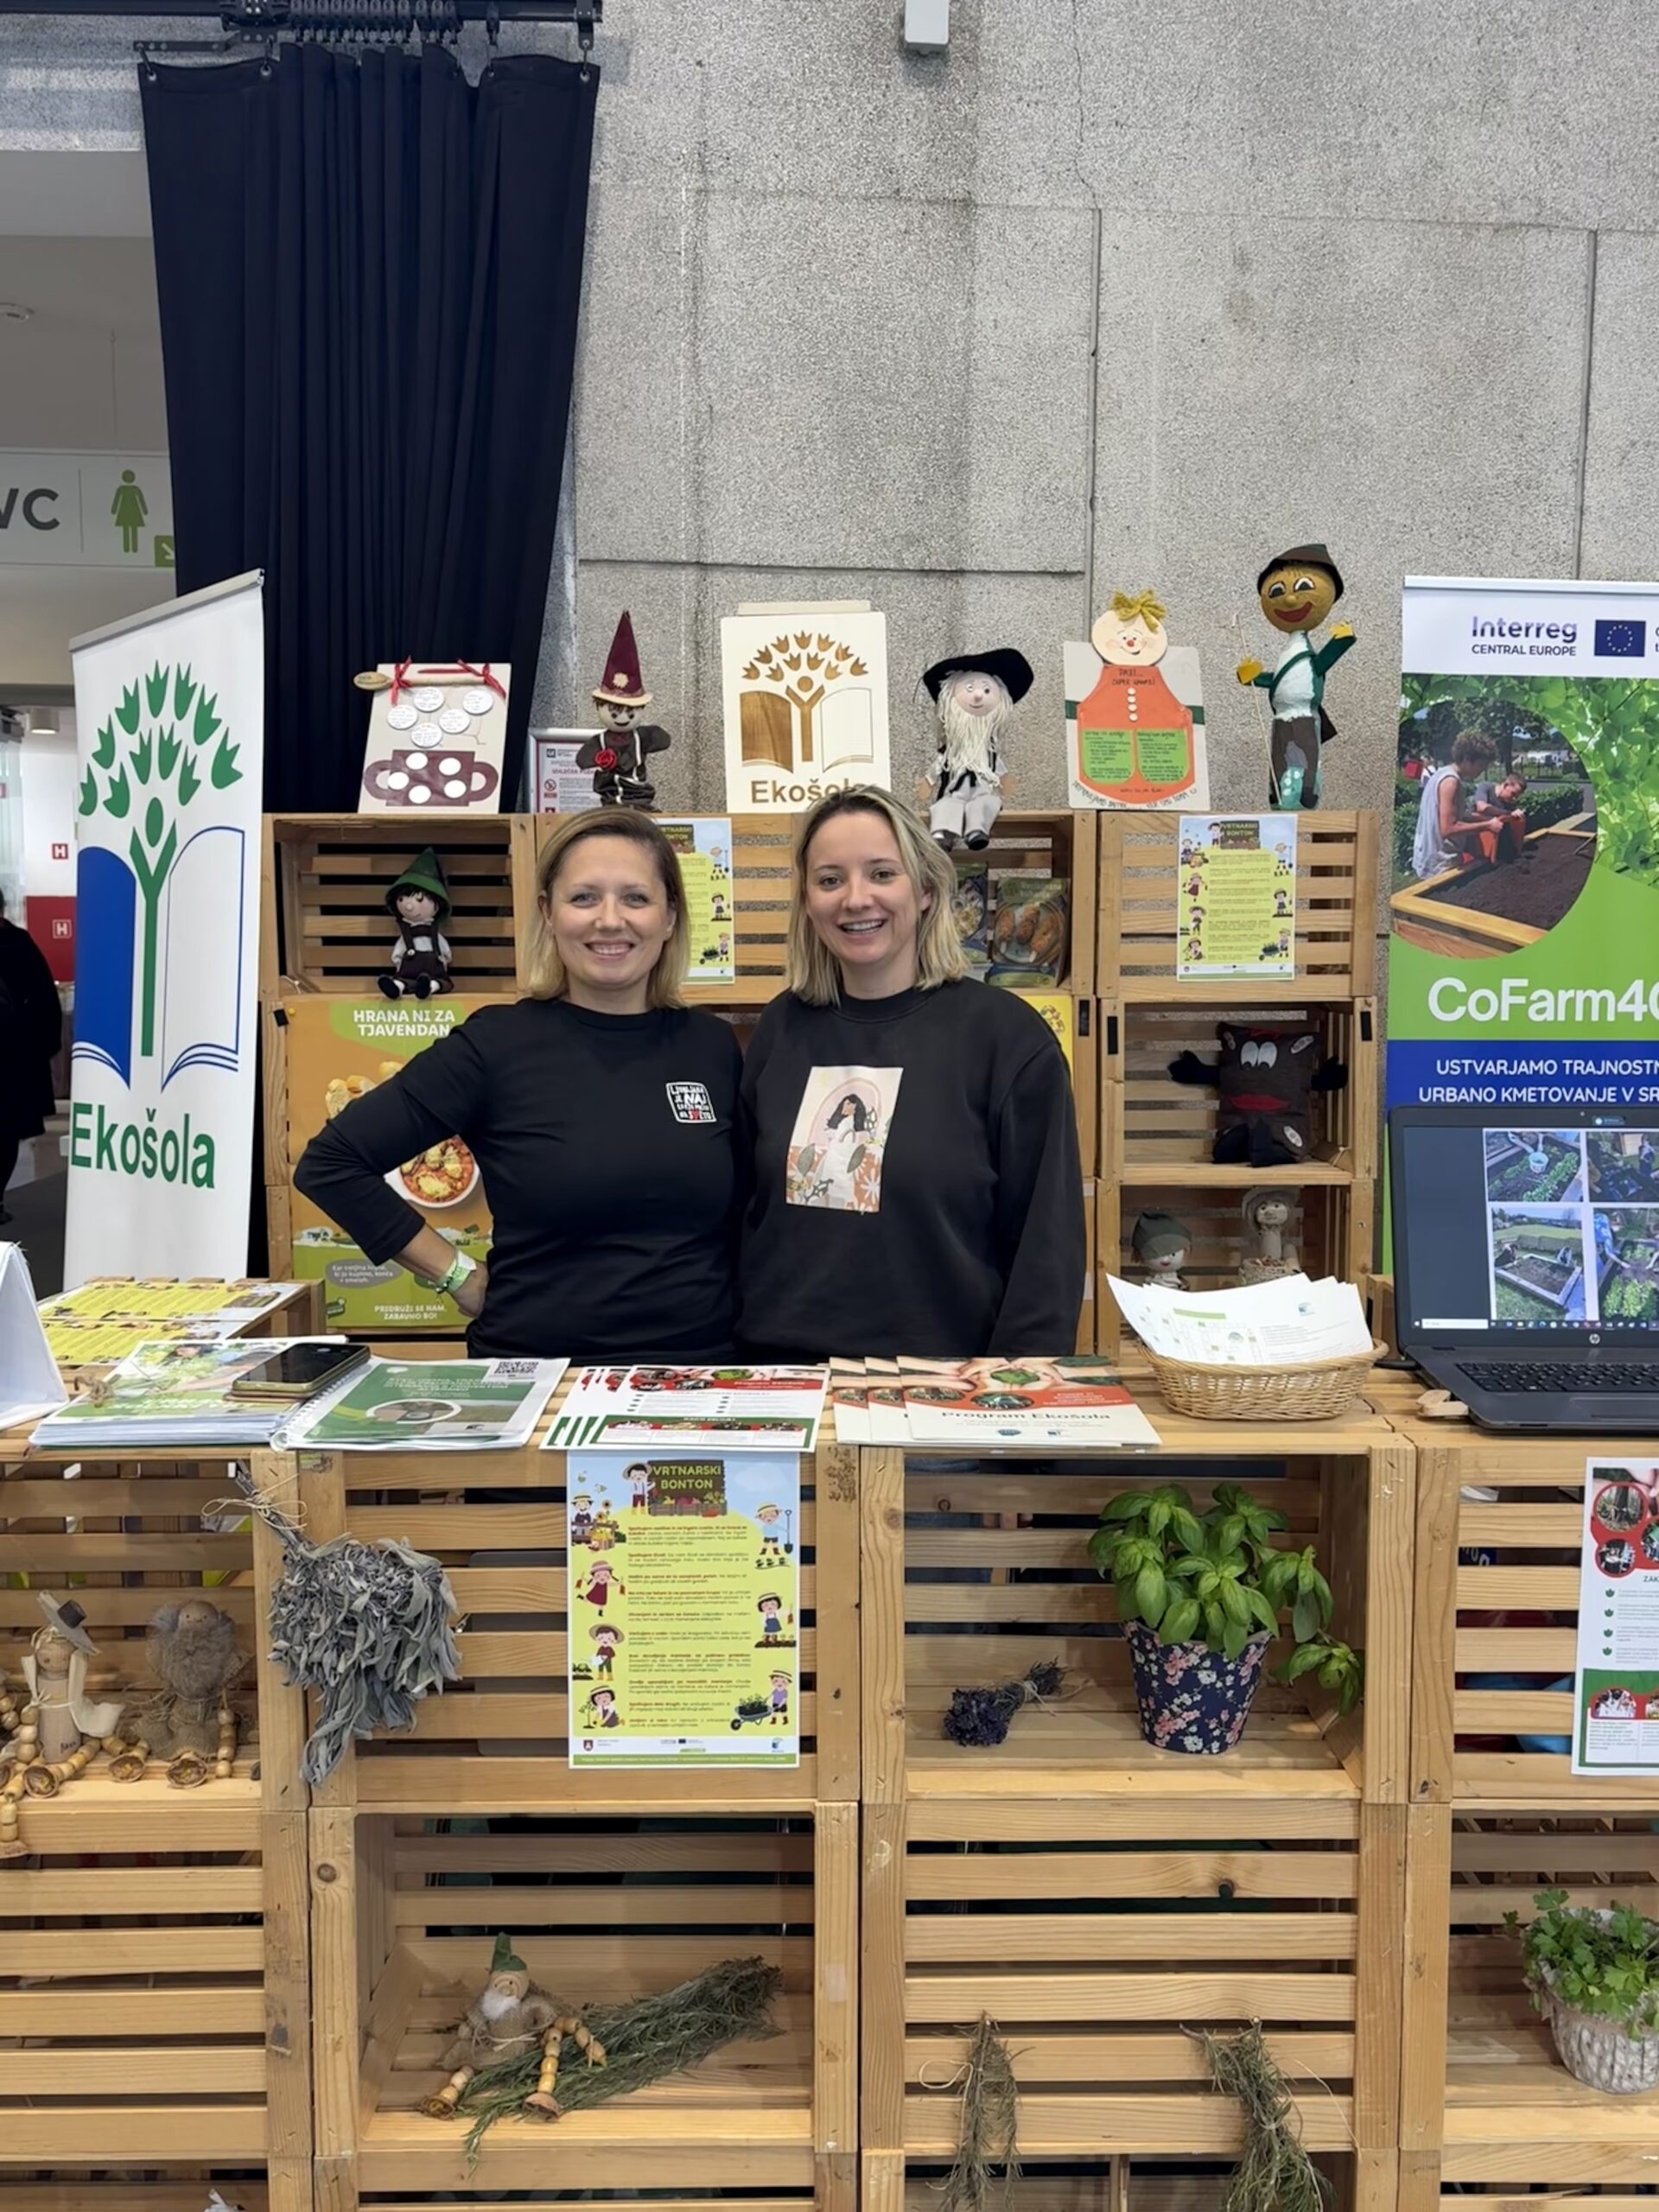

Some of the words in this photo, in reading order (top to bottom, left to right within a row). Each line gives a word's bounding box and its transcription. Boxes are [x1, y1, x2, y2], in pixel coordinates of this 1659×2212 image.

[1471, 616, 1578, 643] Interreg
[1471, 644, 1527, 655] CENTRAL
[1529, 645, 1576, 657] EUROPE
[751, 778, 865, 804] Ekošo
[1428, 976, 1659, 1021] CoFarm4
[353, 1010, 409, 1022] HRANA
[413, 1010, 430, 1022] NI
[435, 1010, 455, 1022] ZA
[1436, 1059, 1557, 1075] USTVARJAMO
[1419, 1087, 1497, 1103] URBANO
[1502, 1087, 1617, 1103] KMETOVANJE
[1622, 1087, 1635, 1102] V
[70, 1102, 215, 1189] Ekošola
[374, 1304, 413, 1313] PRIDRUŽI
[653, 1465, 721, 1476] VRTNARSKI
[660, 1478, 714, 1489] BONTON
